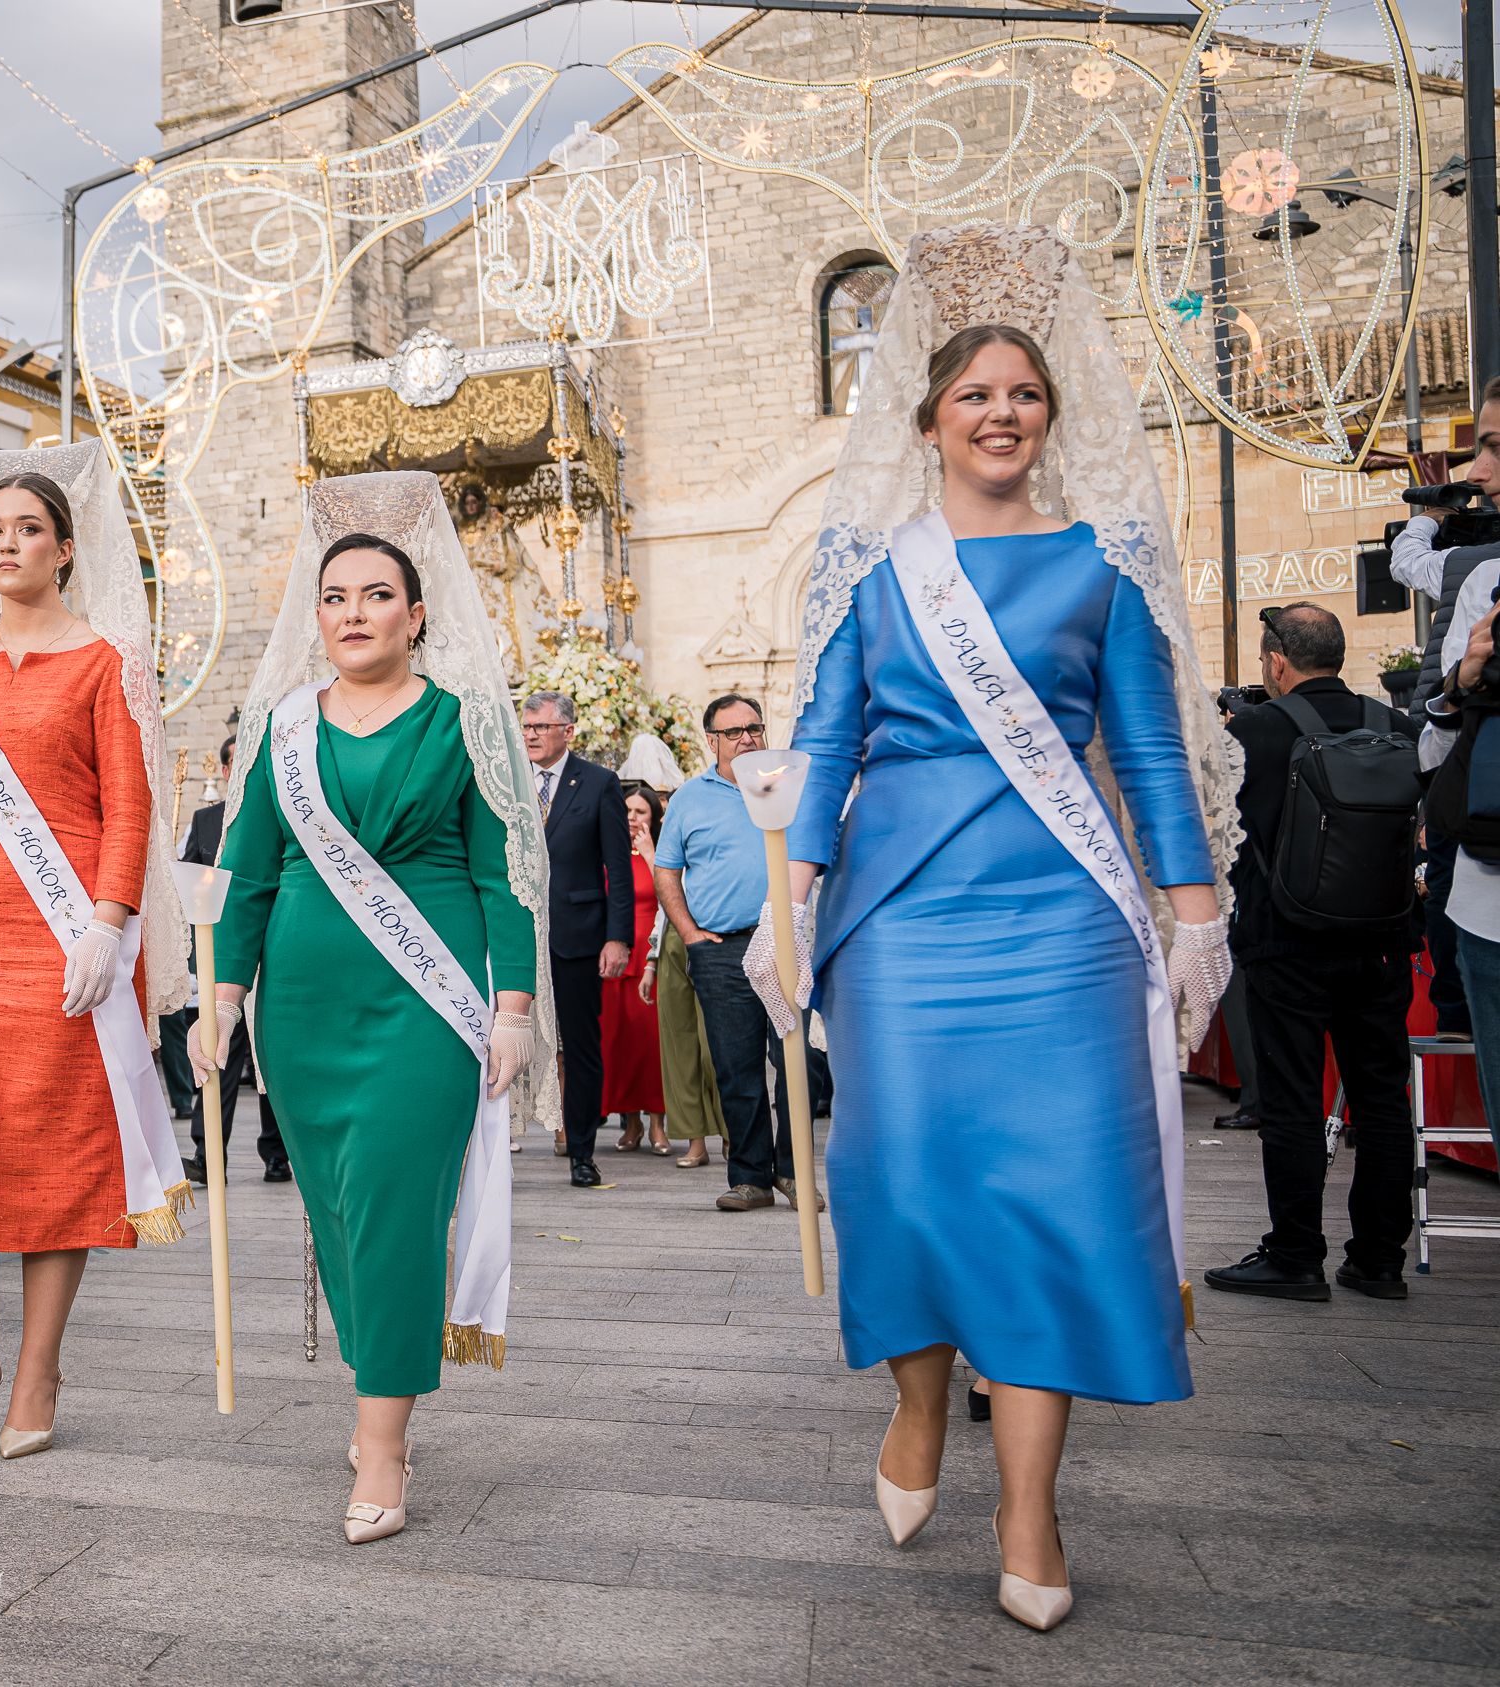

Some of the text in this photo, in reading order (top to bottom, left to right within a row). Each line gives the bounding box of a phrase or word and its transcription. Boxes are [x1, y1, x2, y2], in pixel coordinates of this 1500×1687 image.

[1194, 549, 1357, 602] ARAC
[941, 618, 1007, 707] DAMA
[1004, 726, 1048, 770] DE
[1047, 789, 1125, 892] HONOR
[14, 827, 67, 910] HONOR
[283, 749, 488, 1042] DAMA DE HONOR 2026
